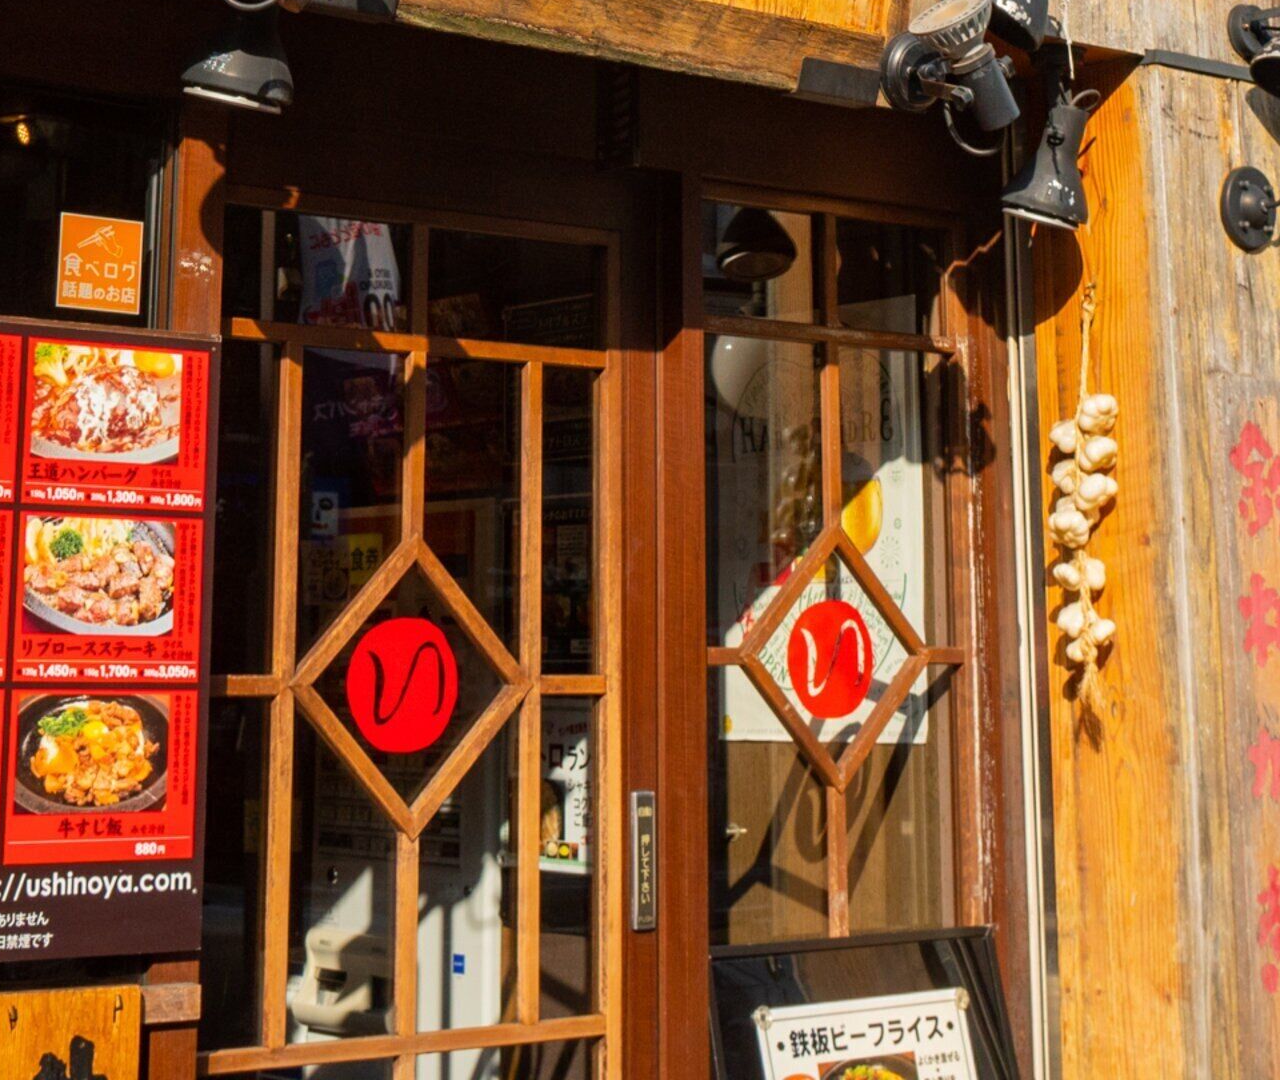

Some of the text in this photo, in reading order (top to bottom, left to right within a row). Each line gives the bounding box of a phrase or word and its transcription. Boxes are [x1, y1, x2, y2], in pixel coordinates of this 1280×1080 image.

[63, 252, 138, 282] 食べログ
[62, 280, 136, 305] 話題のお店
[27, 463, 138, 484] 王道ハンバーグ
[22, 638, 157, 658] リブロースステーキ
[58, 818, 123, 839] 牛すじ飯
